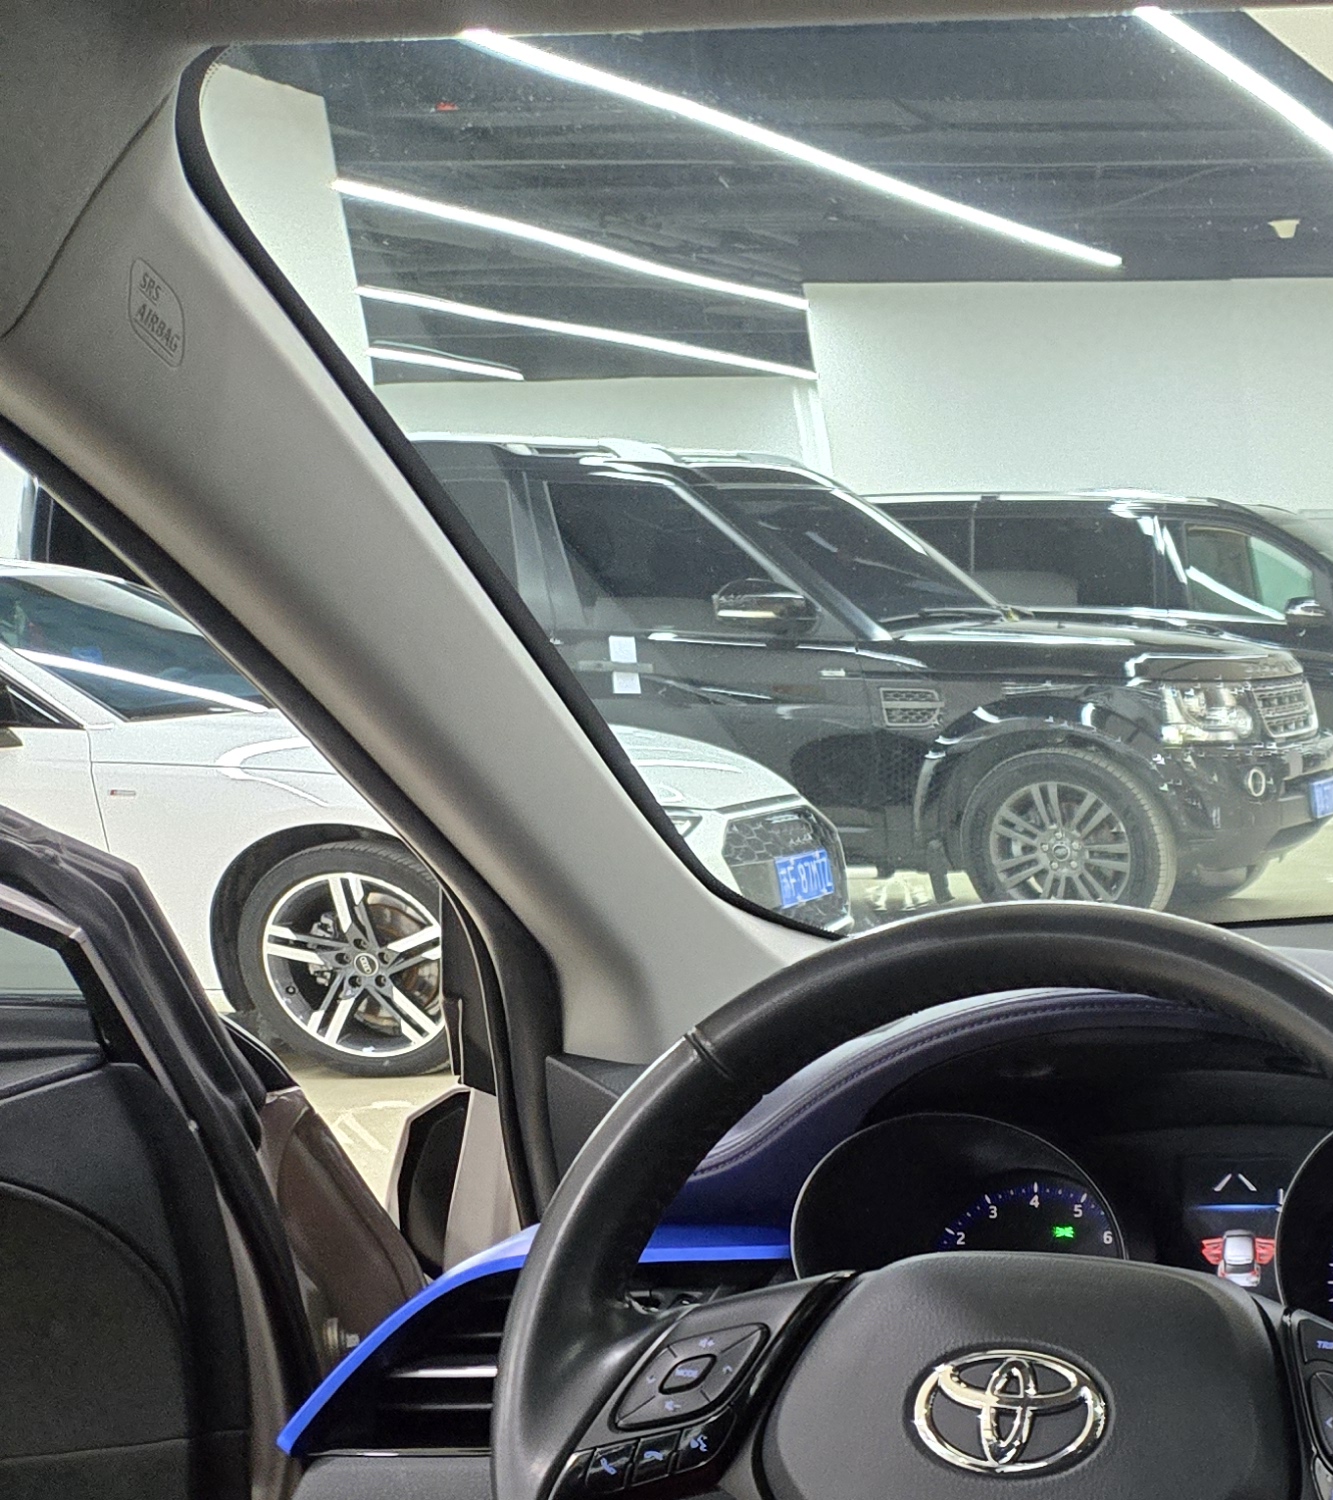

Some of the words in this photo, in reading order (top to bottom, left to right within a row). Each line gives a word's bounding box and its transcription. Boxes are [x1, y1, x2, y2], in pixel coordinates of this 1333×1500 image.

[140, 272, 161, 301] SRS
[135, 303, 180, 353] AIRBAG
[1029, 1194, 1040, 1209] 4
[988, 1205, 998, 1219] 3
[1073, 1204, 1083, 1218] 5
[956, 1231, 966, 1245] 2
[1103, 1230, 1113, 1244] 6
